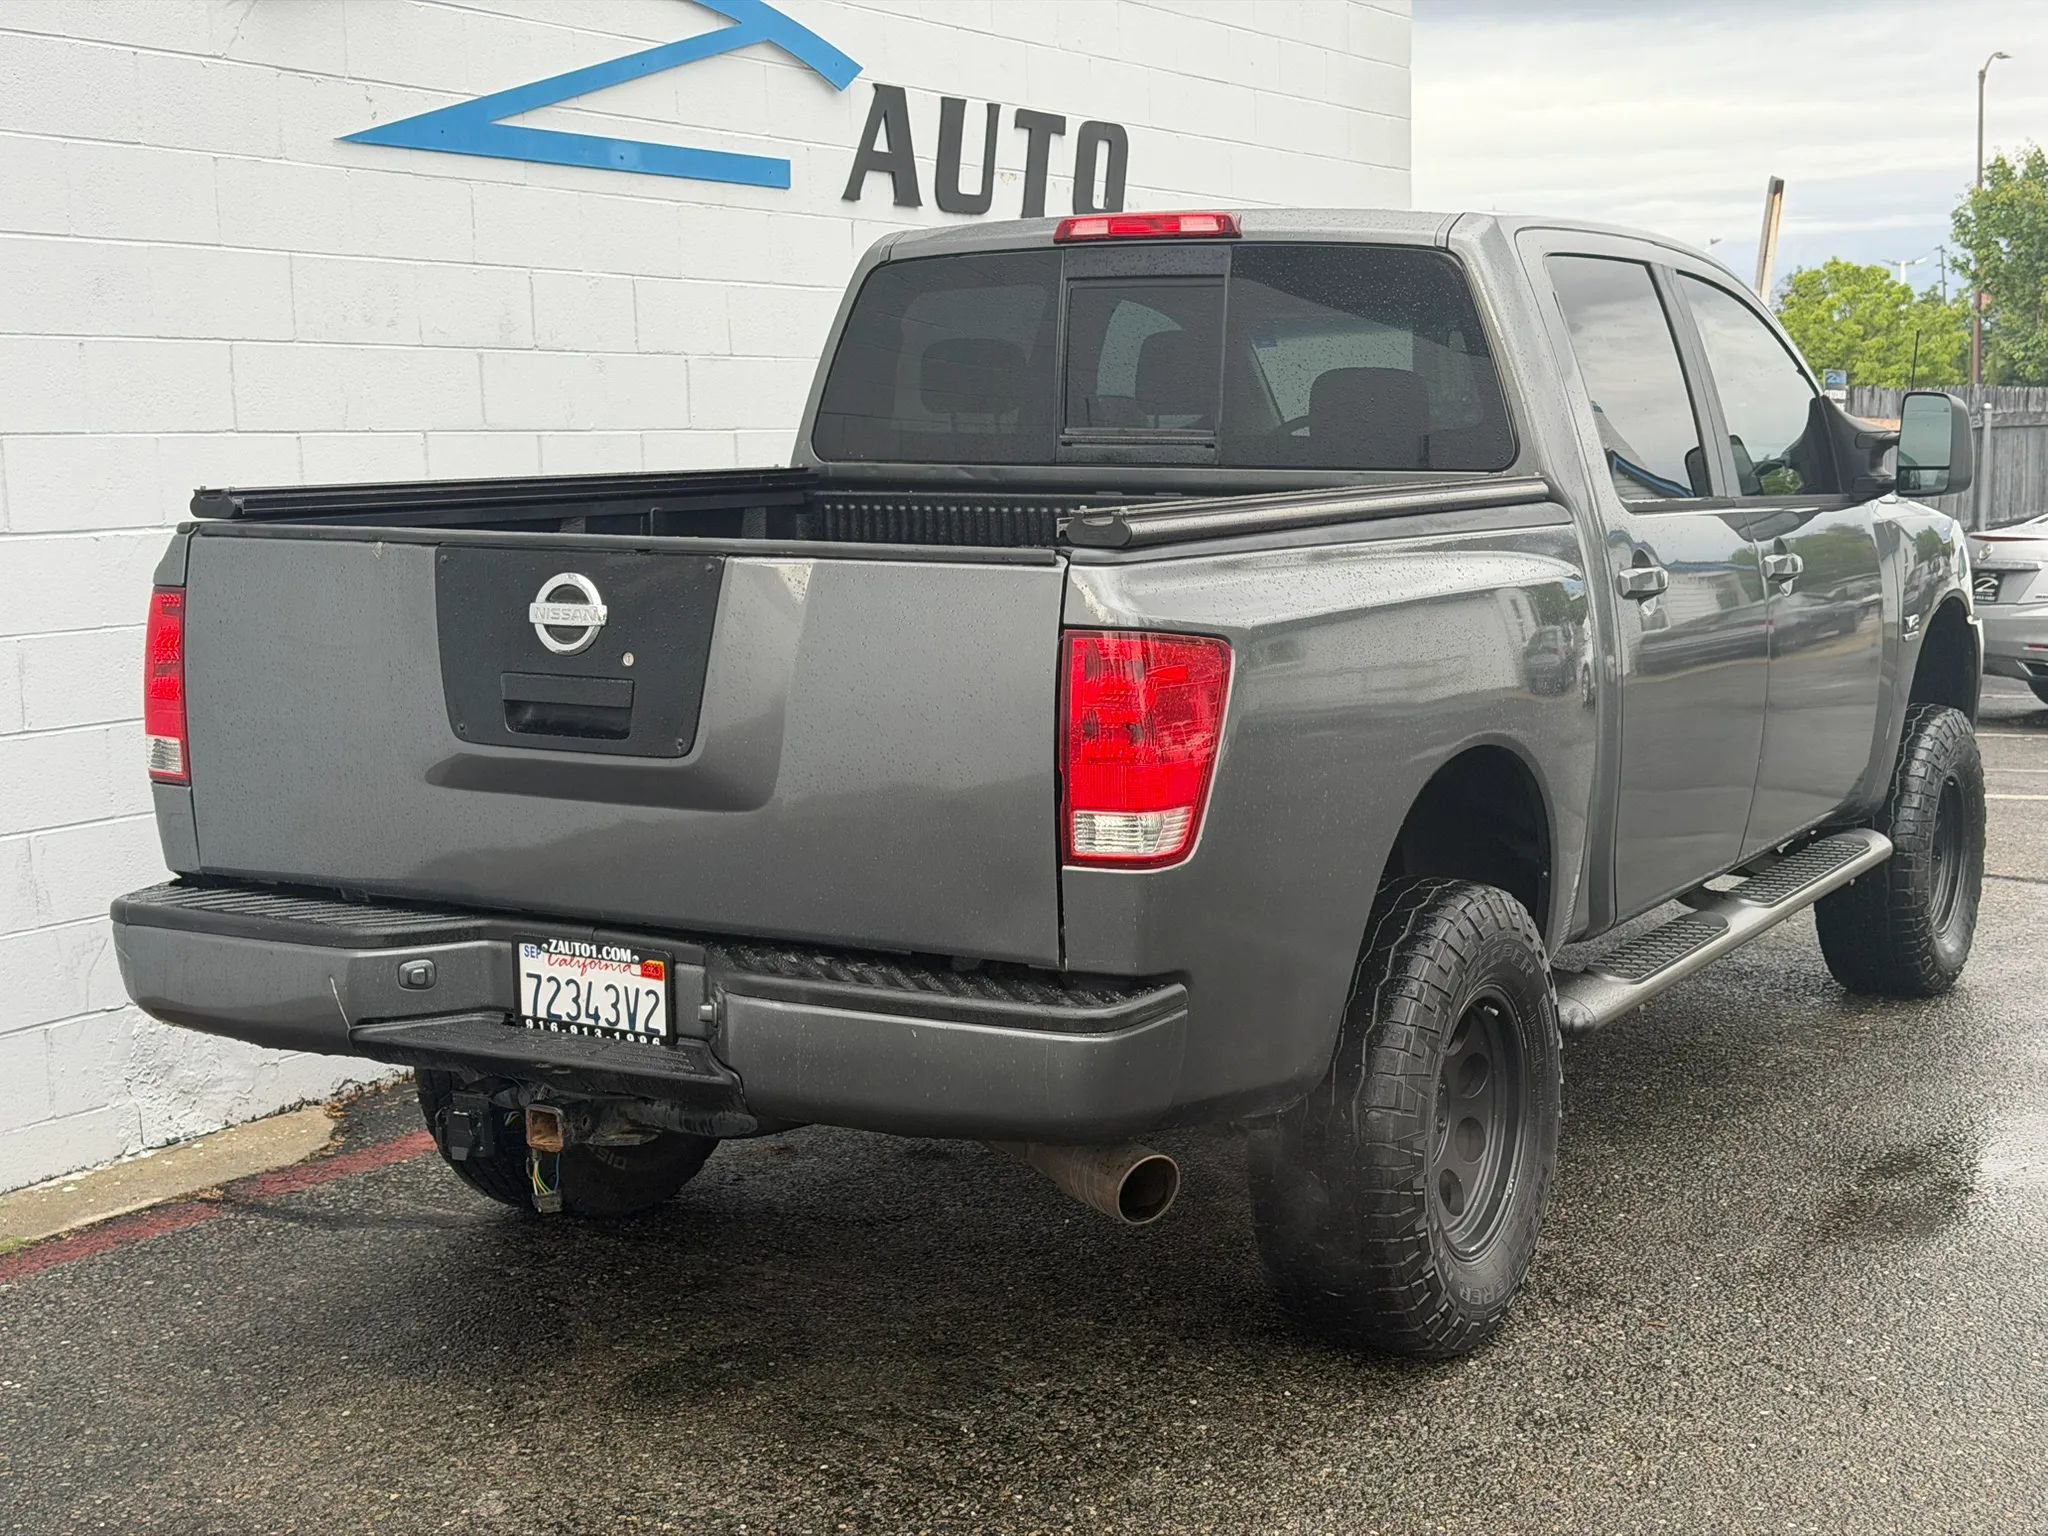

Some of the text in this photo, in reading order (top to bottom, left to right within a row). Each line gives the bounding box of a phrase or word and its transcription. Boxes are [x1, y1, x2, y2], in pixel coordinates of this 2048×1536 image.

[841, 83, 1128, 218] AUTO
[533, 605, 602, 621] NISSAN
[548, 939, 632, 963] ZAUTO1.COM
[525, 972, 661, 1036] 72343V2
